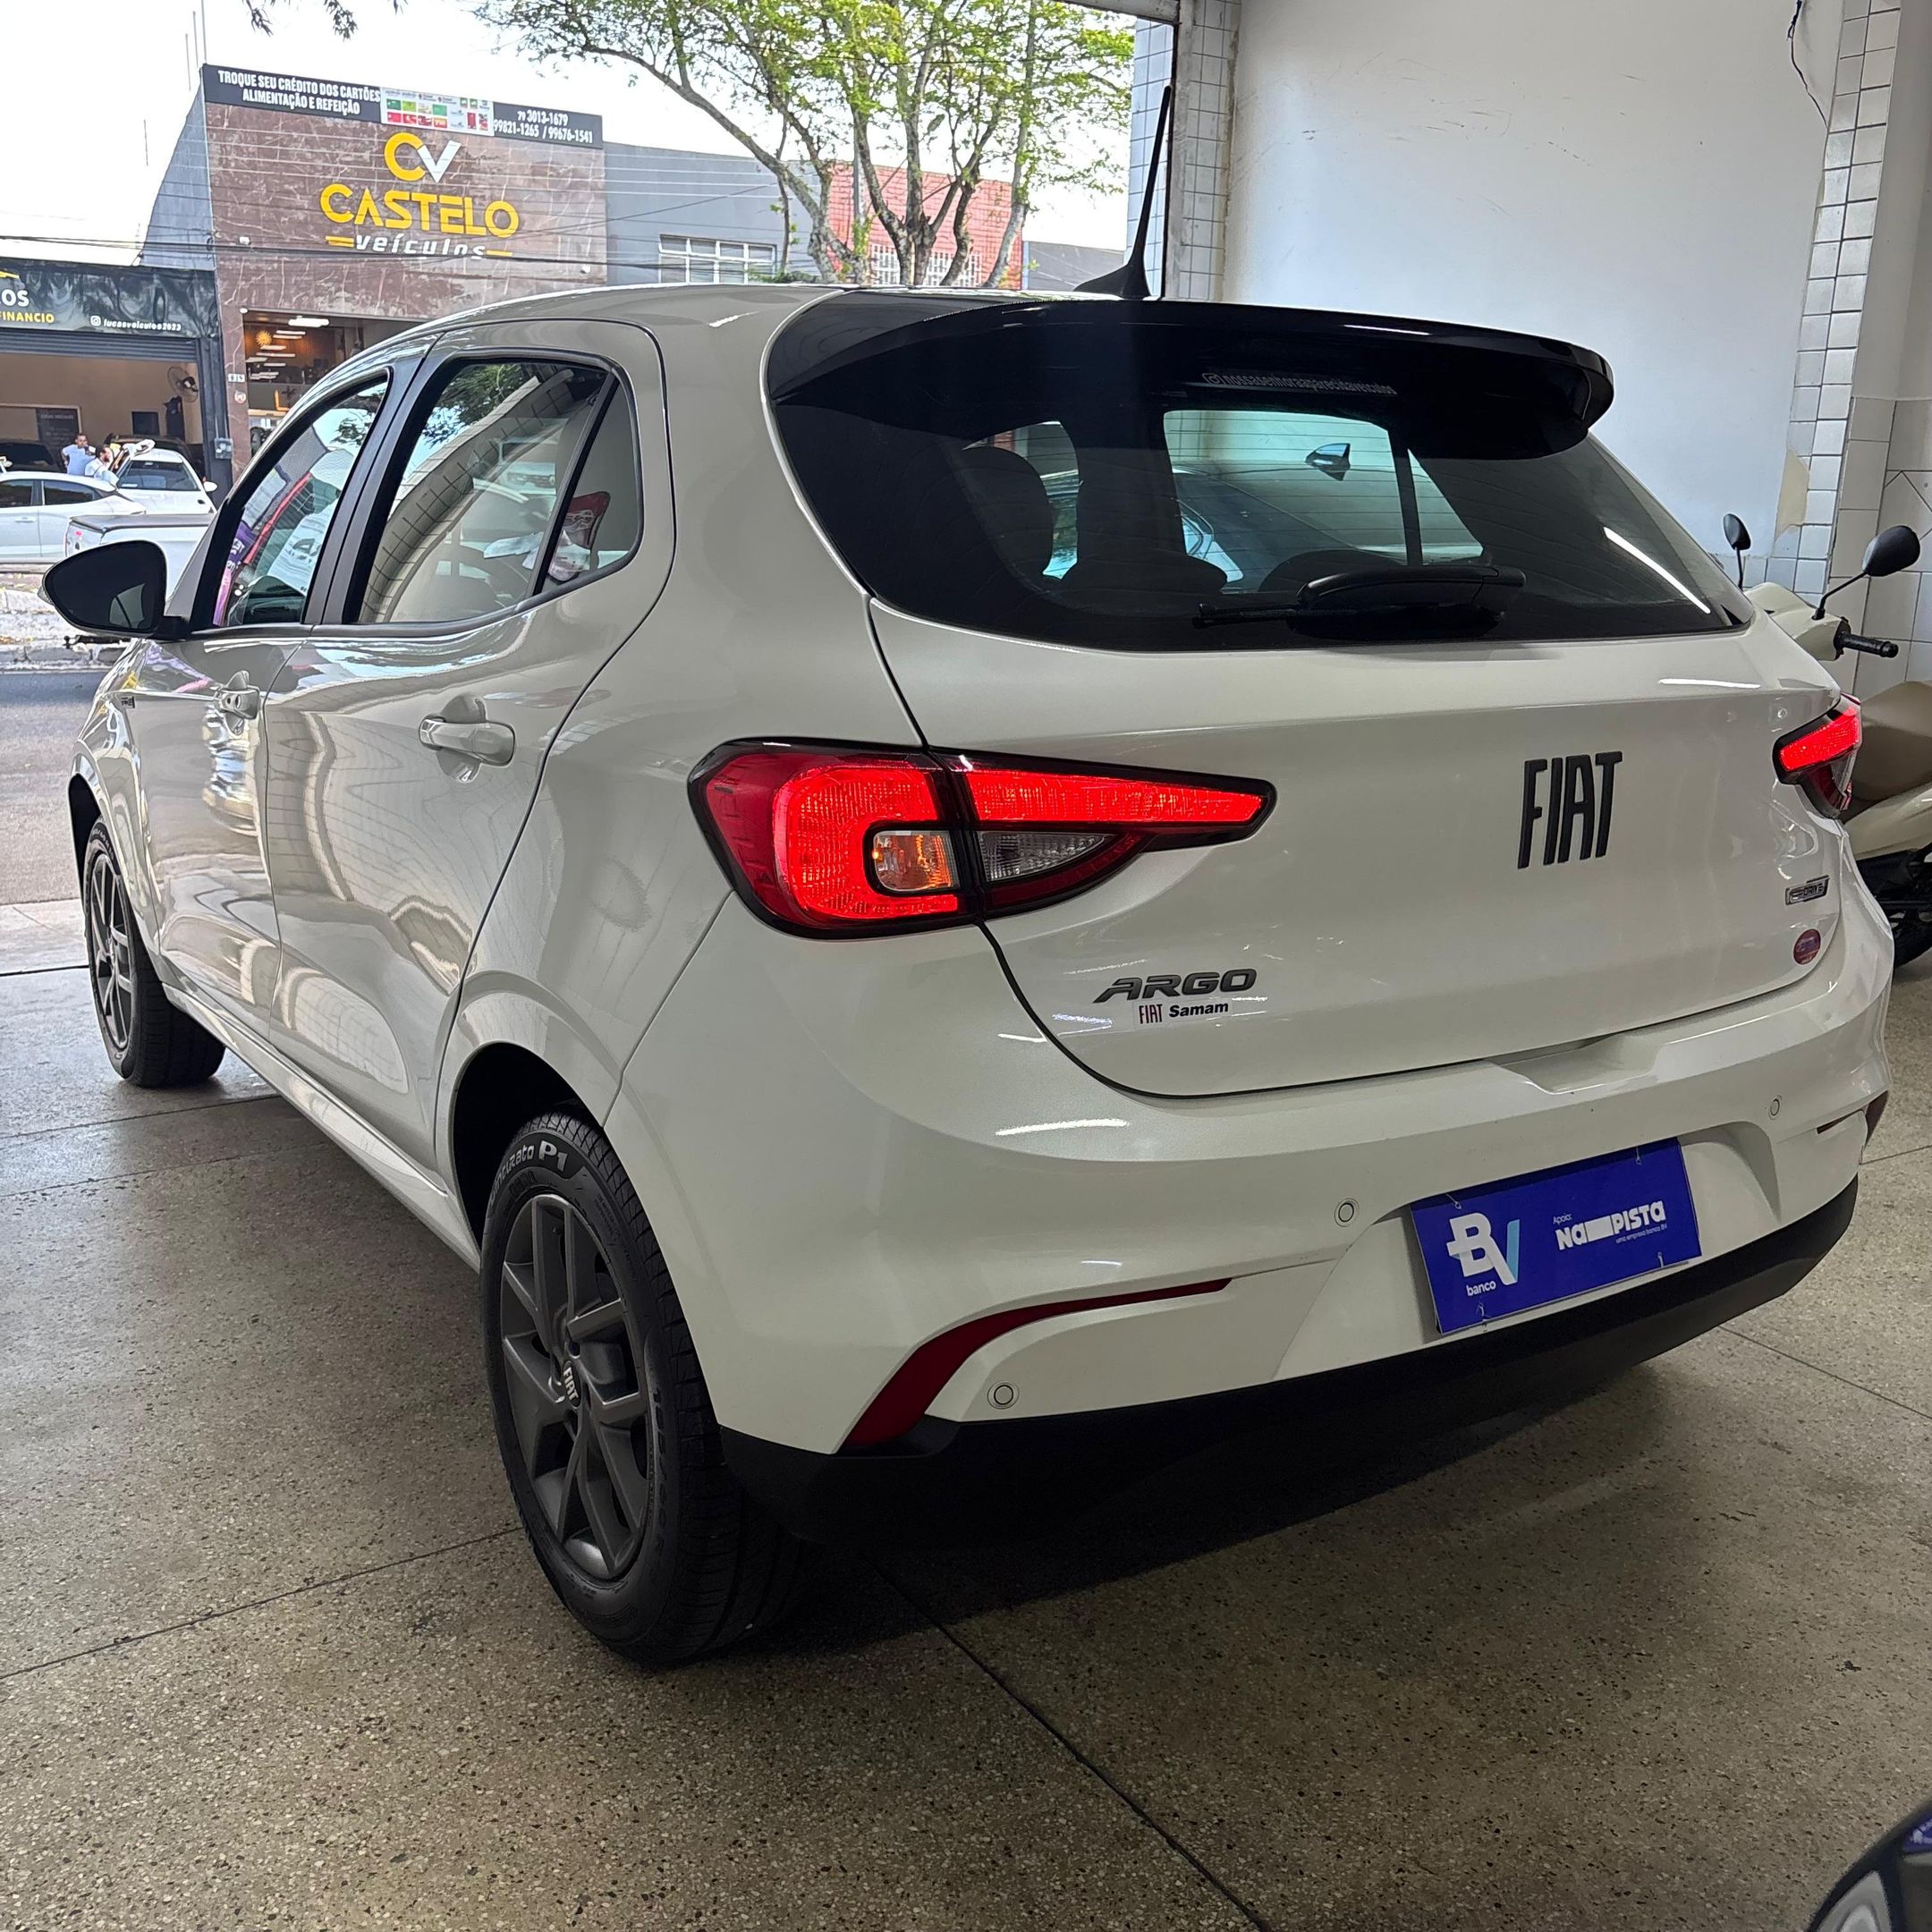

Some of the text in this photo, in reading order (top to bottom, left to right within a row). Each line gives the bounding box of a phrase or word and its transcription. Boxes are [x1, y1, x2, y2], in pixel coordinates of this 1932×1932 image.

[217, 70, 381, 103] TROQUE SEU CRÉDITO DOS CARTÕES
[242, 89, 360, 116] ALIMENTAÇÃO E REFEIÇÃO
[526, 109, 569, 126] 3013-1679
[319, 183, 520, 238] CASTELO
[356, 233, 487, 260] veículos
[1517, 750, 1623, 869] FIAT
[1092, 968, 1258, 1004] ARGO
[1139, 1002, 1229, 1024] FIAT Samam
[538, 1140, 568, 1172] P1
[1466, 1280, 1497, 1297] banco
[563, 1367, 579, 1401] FIAT
